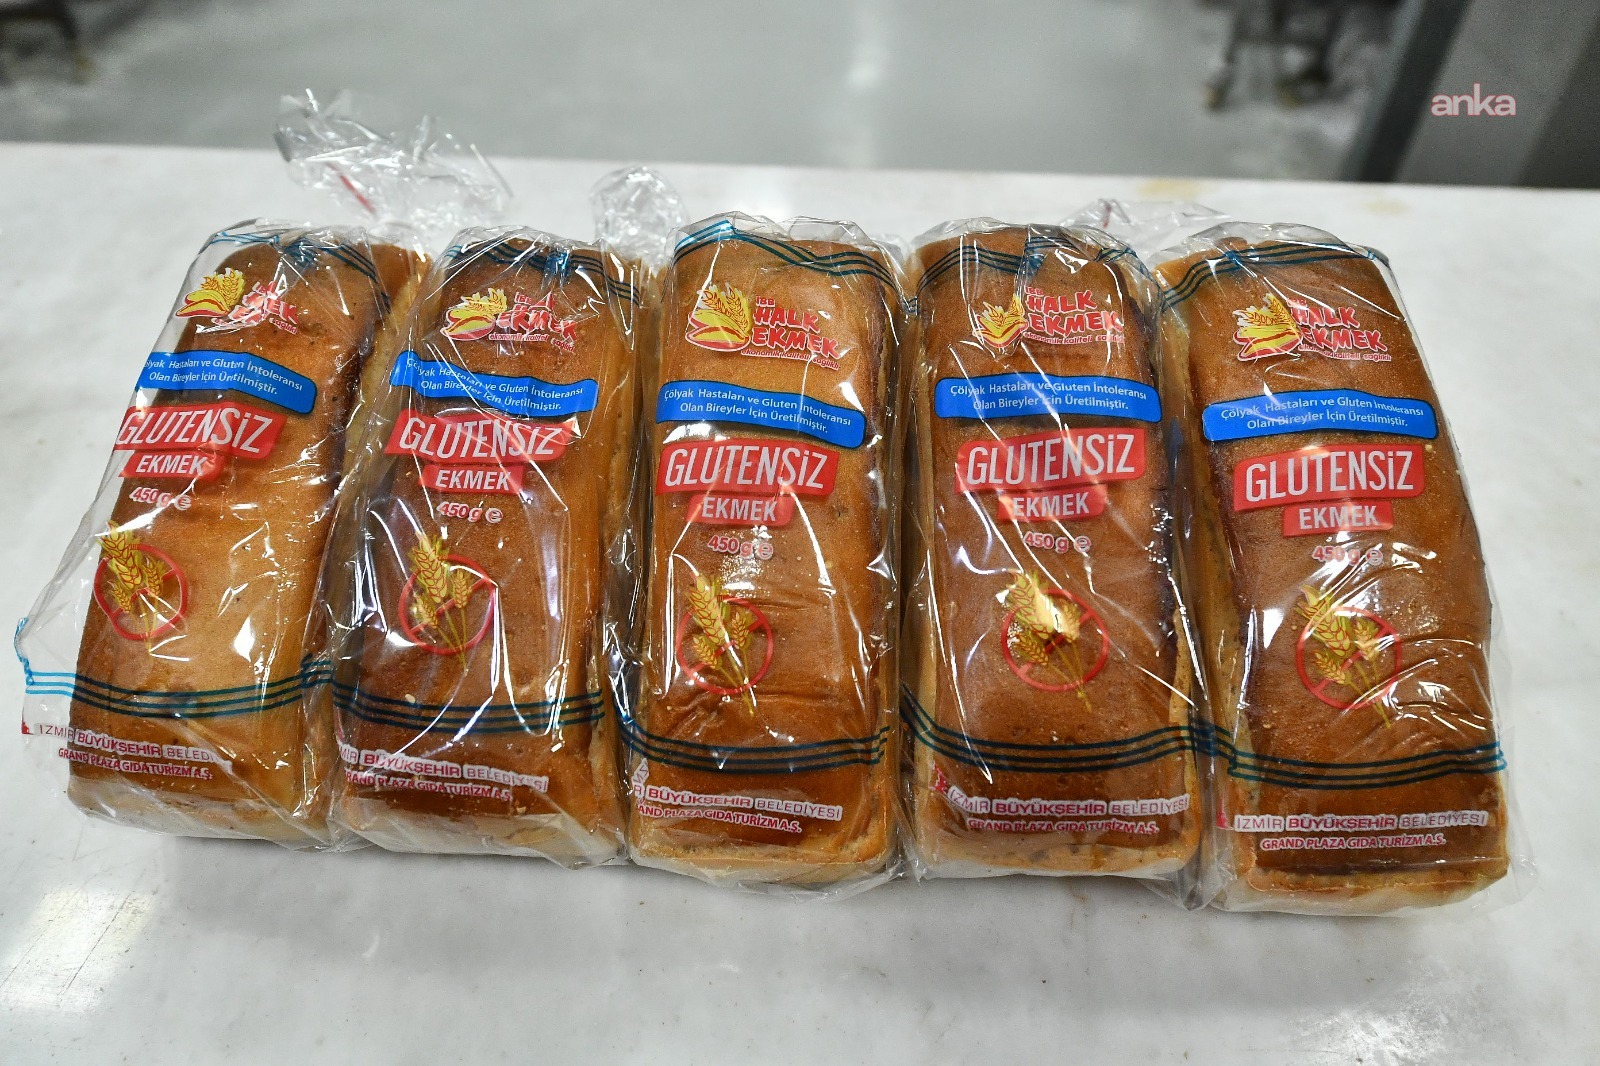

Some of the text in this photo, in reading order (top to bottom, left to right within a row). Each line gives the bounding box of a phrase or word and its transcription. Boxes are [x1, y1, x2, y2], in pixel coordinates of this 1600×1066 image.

[1026, 290, 1098, 315] HALK
[753, 306, 821, 333] HALK
[1028, 311, 1124, 336] EKMEK
[1290, 307, 1360, 328] HALK
[751, 327, 841, 359] EKMEK
[1300, 326, 1388, 352] EKMEK
[201, 359, 211, 367] ve
[149, 371, 170, 382] Olan
[420, 380, 442, 390] Olan
[485, 383, 497, 391] ve
[499, 383, 529, 393] Gluten
[950, 384, 985, 399] Çölyak
[989, 381, 1035, 393] Hastaları
[1038, 382, 1050, 390] ve
[1053, 382, 1091, 392] Gluten
[664, 388, 694, 401] Çölyak
[698, 388, 745, 402] Hastaları
[748, 397, 760, 405] ve
[761, 398, 798, 410] Gluten
[973, 399, 996, 410] Olan
[998, 396, 1039, 410] Bireyler
[1064, 393, 1129, 410] Üretilmiştir.
[1221, 405, 1260, 421] Çölyak
[1264, 398, 1318, 413] Hastaları
[1320, 398, 1335, 407] ve
[1336, 396, 1373, 409] Gluten
[680, 402, 829, 434] Olan Bireyler İçin Üretilmiştir.
[1247, 409, 1409, 430] Olan Bireyler İçin Üretilmiştir.
[135, 454, 209, 475] EKMEK
[435, 469, 511, 491] EKMEK
[702, 496, 778, 522] EKMEK
[1013, 491, 1089, 517] EKMEK
[1299, 505, 1379, 530] EKMEK
[58, 747, 89, 763] GRAND
[90, 755, 120, 771] PLAZA
[345, 770, 375, 786] RAND
[664, 809, 701, 817] PLAZA
[704, 810, 732, 822] GIDA
[968, 819, 1012, 832] GRAND
[1055, 822, 1087, 832] GIDA
[1262, 838, 1305, 850] GRAND
[1306, 838, 1345, 849] PLAZA
[1347, 836, 1378, 849] GIDA
